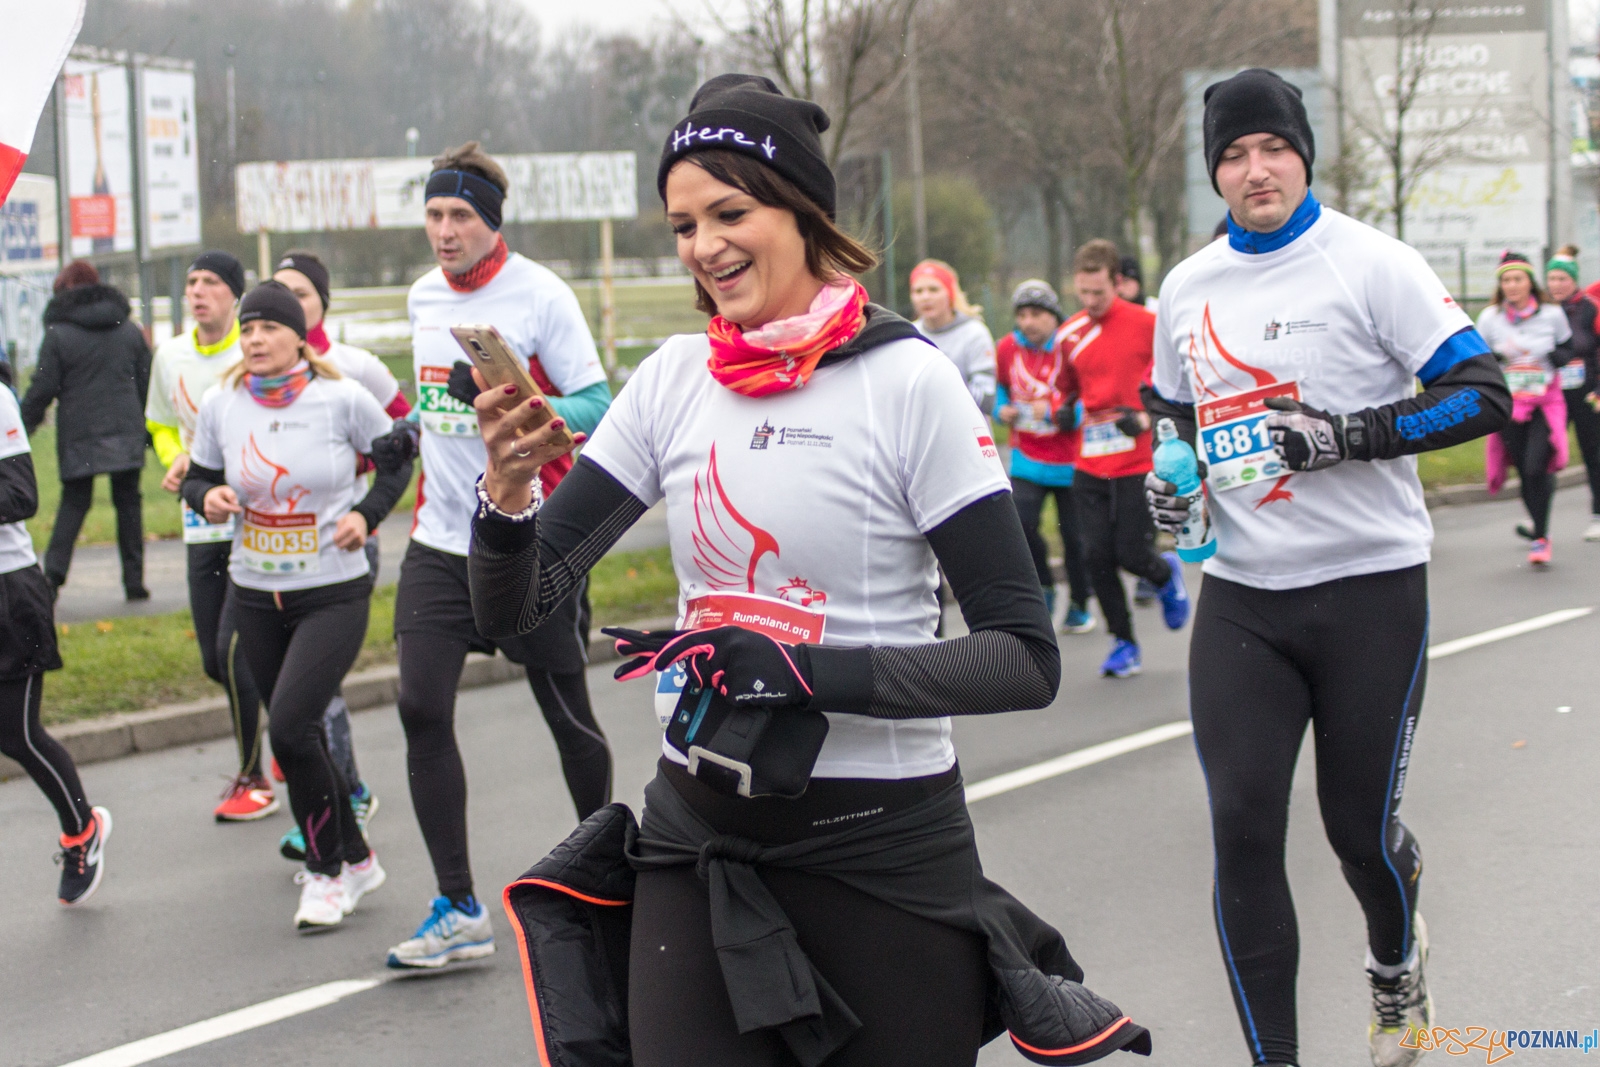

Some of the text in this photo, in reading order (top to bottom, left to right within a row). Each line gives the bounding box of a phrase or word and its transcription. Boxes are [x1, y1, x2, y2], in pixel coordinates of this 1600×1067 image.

[672, 122, 756, 152] Here
[777, 427, 786, 445] 1
[250, 527, 316, 553] 10035
[732, 611, 811, 640] RunPoland.org
